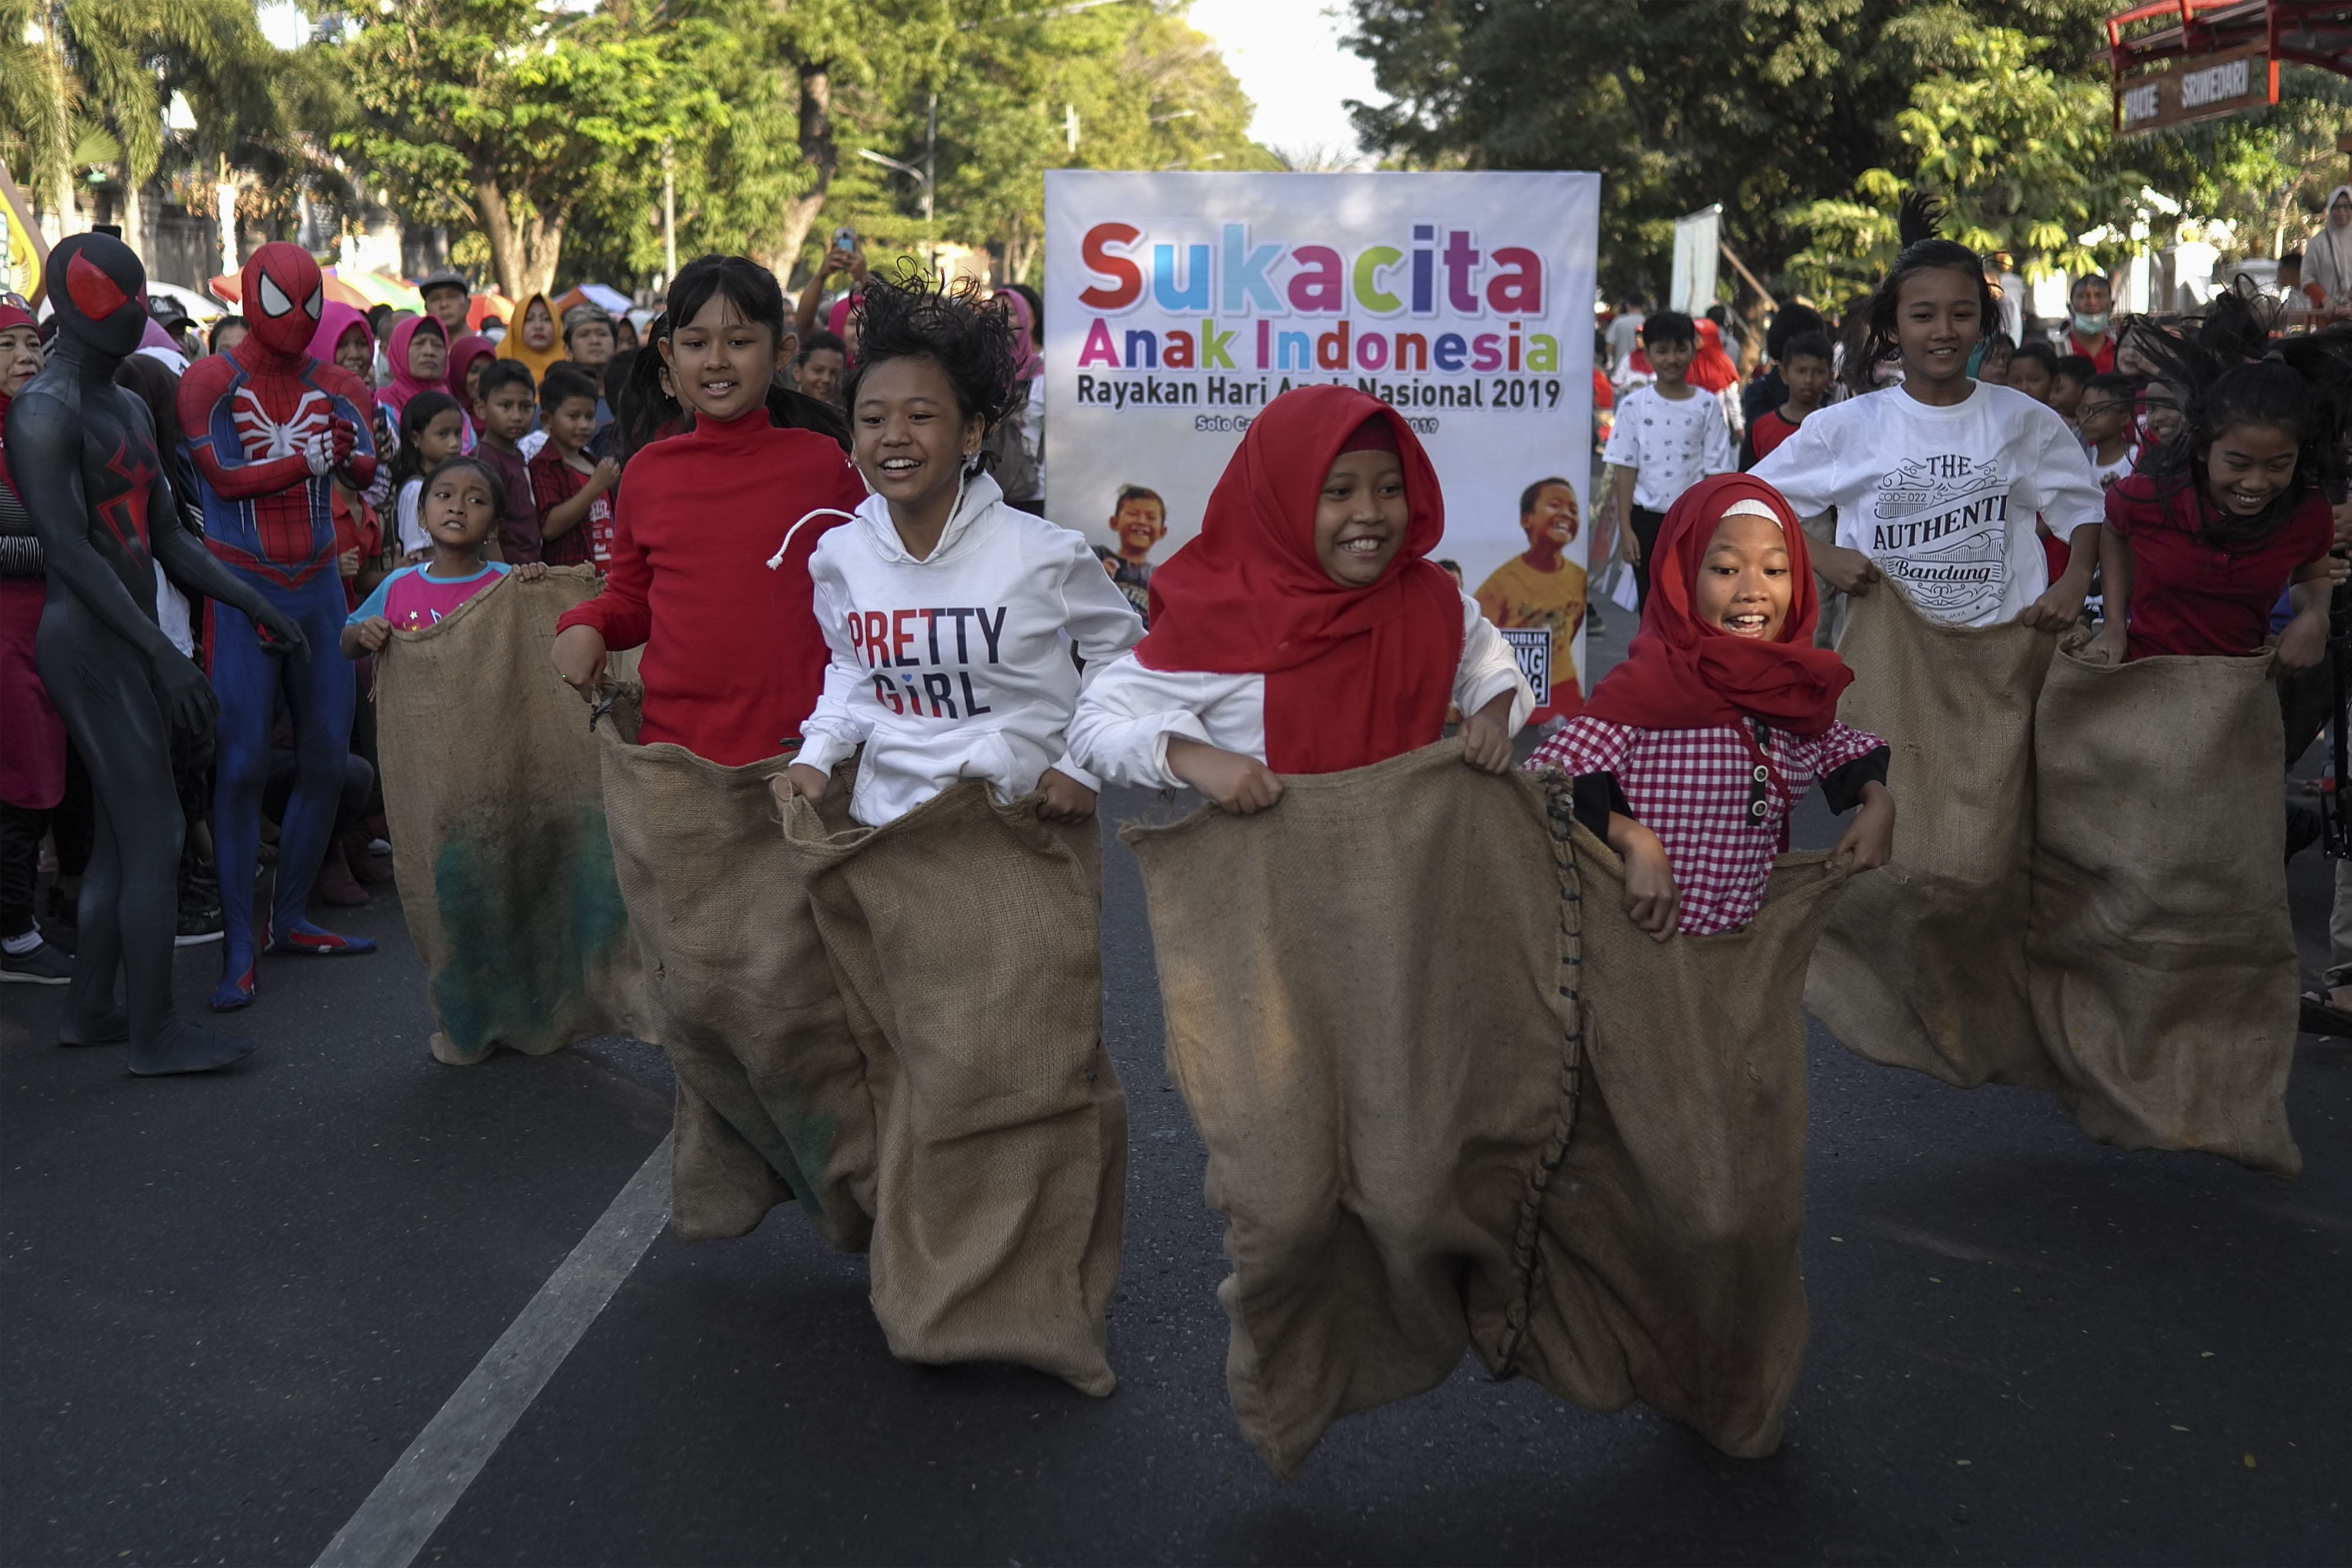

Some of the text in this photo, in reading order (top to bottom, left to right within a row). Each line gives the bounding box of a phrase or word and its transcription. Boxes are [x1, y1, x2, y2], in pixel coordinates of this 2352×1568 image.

[2182, 59, 2249, 109] SRIWEDARI
[1078, 222, 1542, 313] Sukacita
[1078, 317, 1558, 372] Anak Indonesia
[1078, 375, 1198, 409] Rayakan
[1208, 377, 1266, 405] Hari
[1358, 378, 1482, 407] Nasional
[1493, 379, 1560, 407] 2019
[1195, 415, 1232, 432] Solo
[1406, 417, 1439, 434] 019
[1926, 454, 1972, 479] THE
[1896, 560, 1990, 584] Bandung
[1949, 611, 1966, 619] JAVA
[848, 607, 1007, 669] PRETTY
